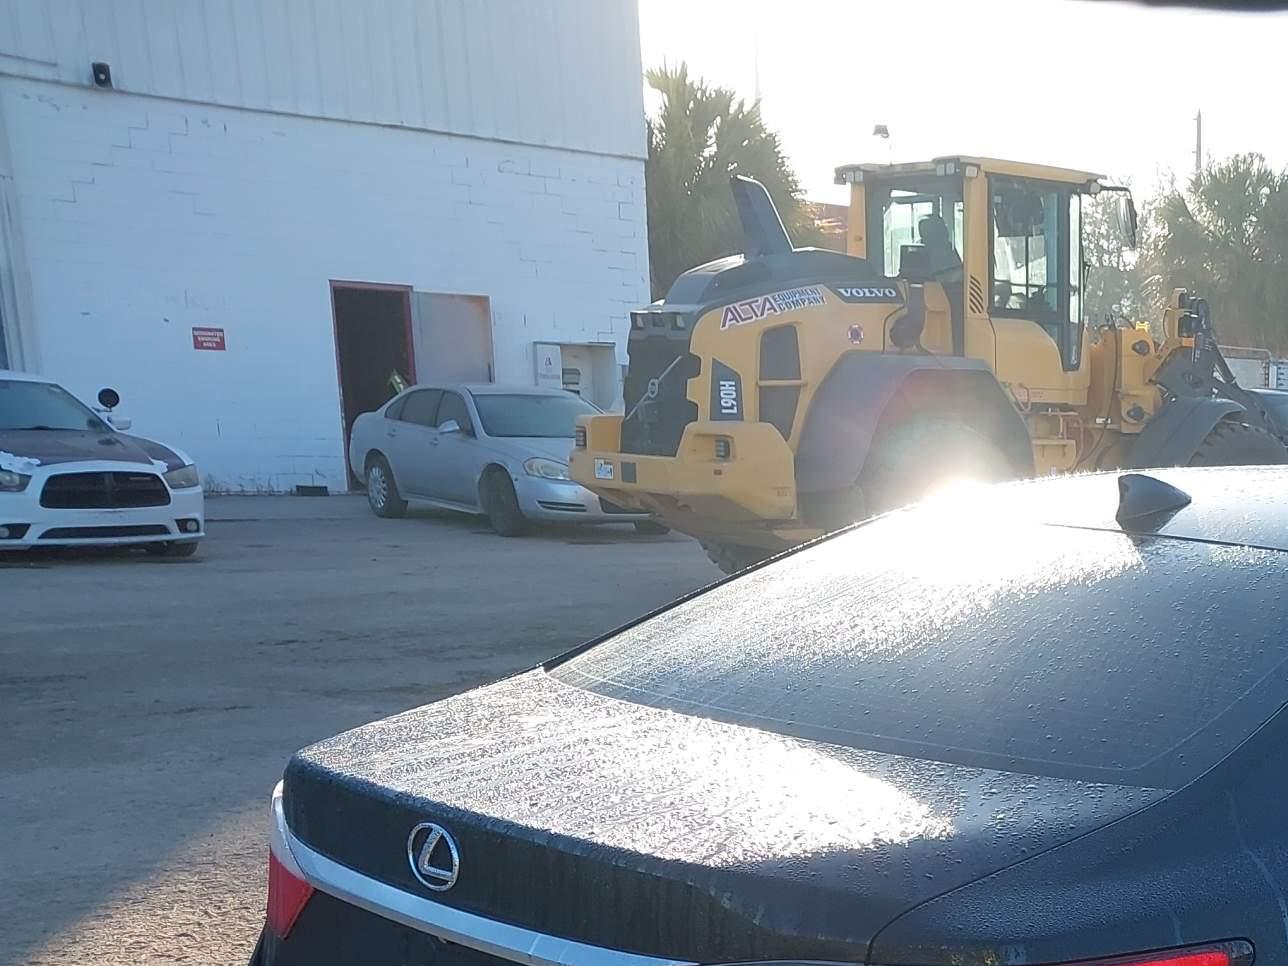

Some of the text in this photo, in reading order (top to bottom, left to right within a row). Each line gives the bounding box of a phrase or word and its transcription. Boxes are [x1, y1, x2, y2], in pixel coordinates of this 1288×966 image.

[774, 286, 822, 301] EQUIPMENT
[838, 287, 896, 298] VOLVO
[777, 296, 827, 312] COMPANY
[720, 296, 778, 330] ALTA
[720, 380, 738, 414] L90H
